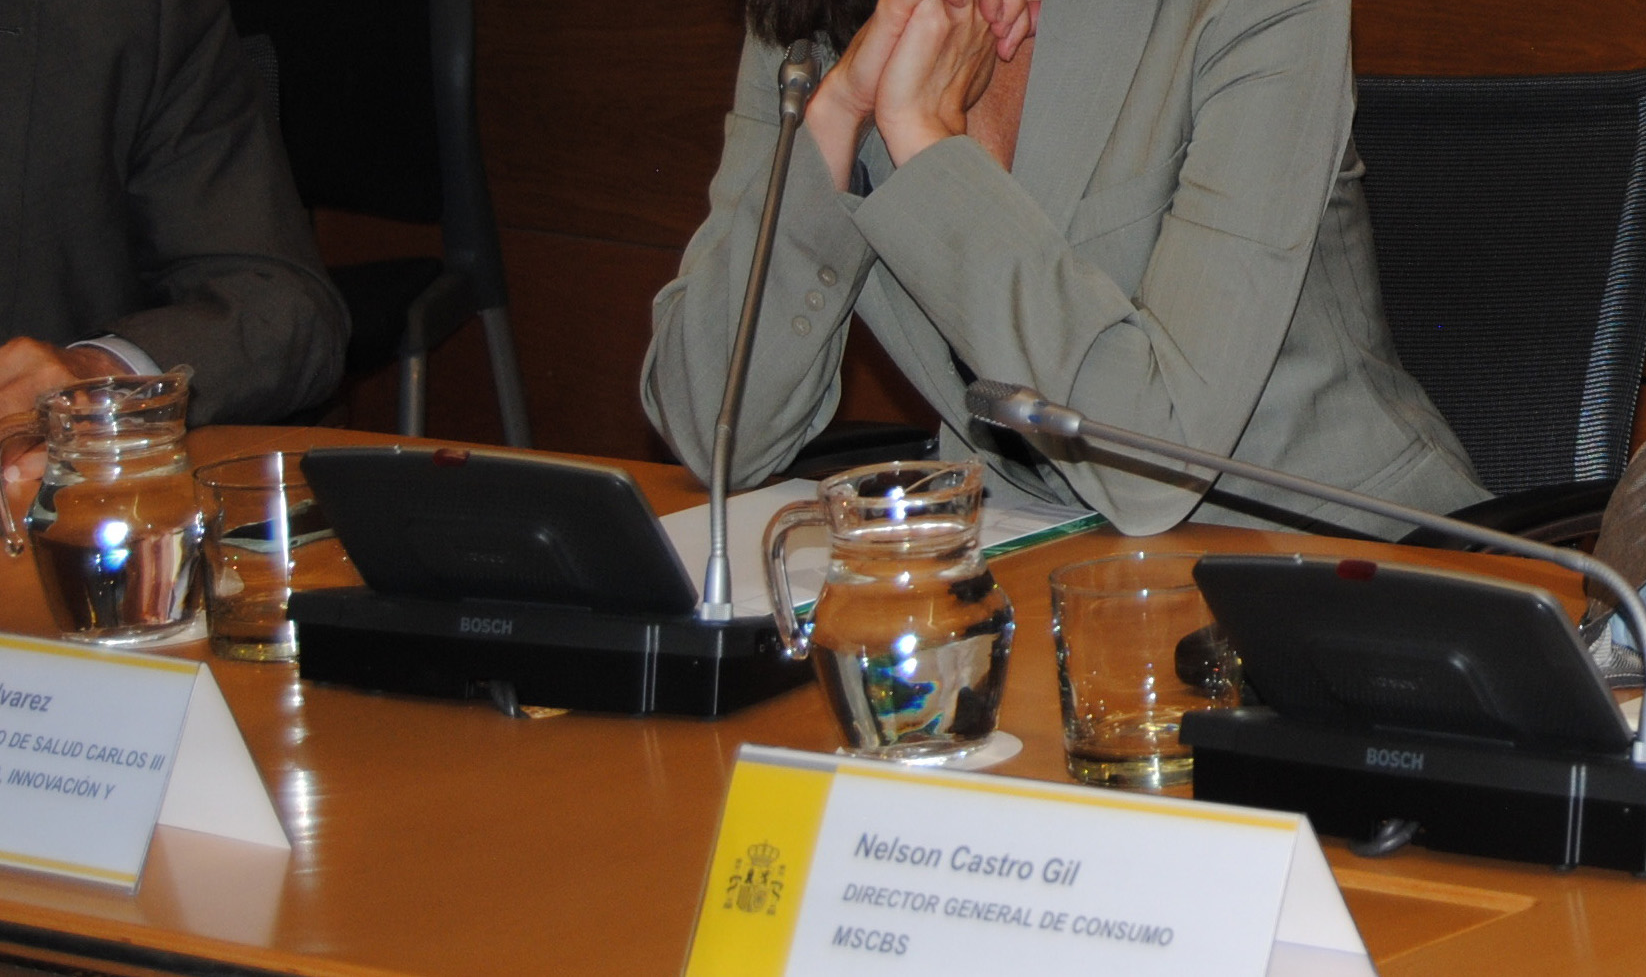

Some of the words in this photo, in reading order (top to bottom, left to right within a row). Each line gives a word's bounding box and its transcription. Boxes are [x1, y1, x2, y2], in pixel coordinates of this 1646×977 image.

[460, 616, 512, 635] BOSCH
[8, 732, 32, 750] DE
[33, 736, 83, 758] SALUD
[86, 744, 148, 769] CARLOS
[149, 754, 165, 771] III
[1366, 747, 1424, 770] BOSCH
[7, 768, 101, 798] INNOVACIÓN
[103, 783, 116, 800] Y
[854, 832, 942, 868] Nelson
[951, 845, 1034, 880] Castro
[1042, 858, 1081, 886] Gil
[842, 883, 940, 914] DIRECTOR
[944, 897, 1033, 928] GENERAL
[1039, 910, 1068, 932] DE
[1072, 915, 1174, 947] CONSUMO
[831, 925, 910, 956] MSCBS
